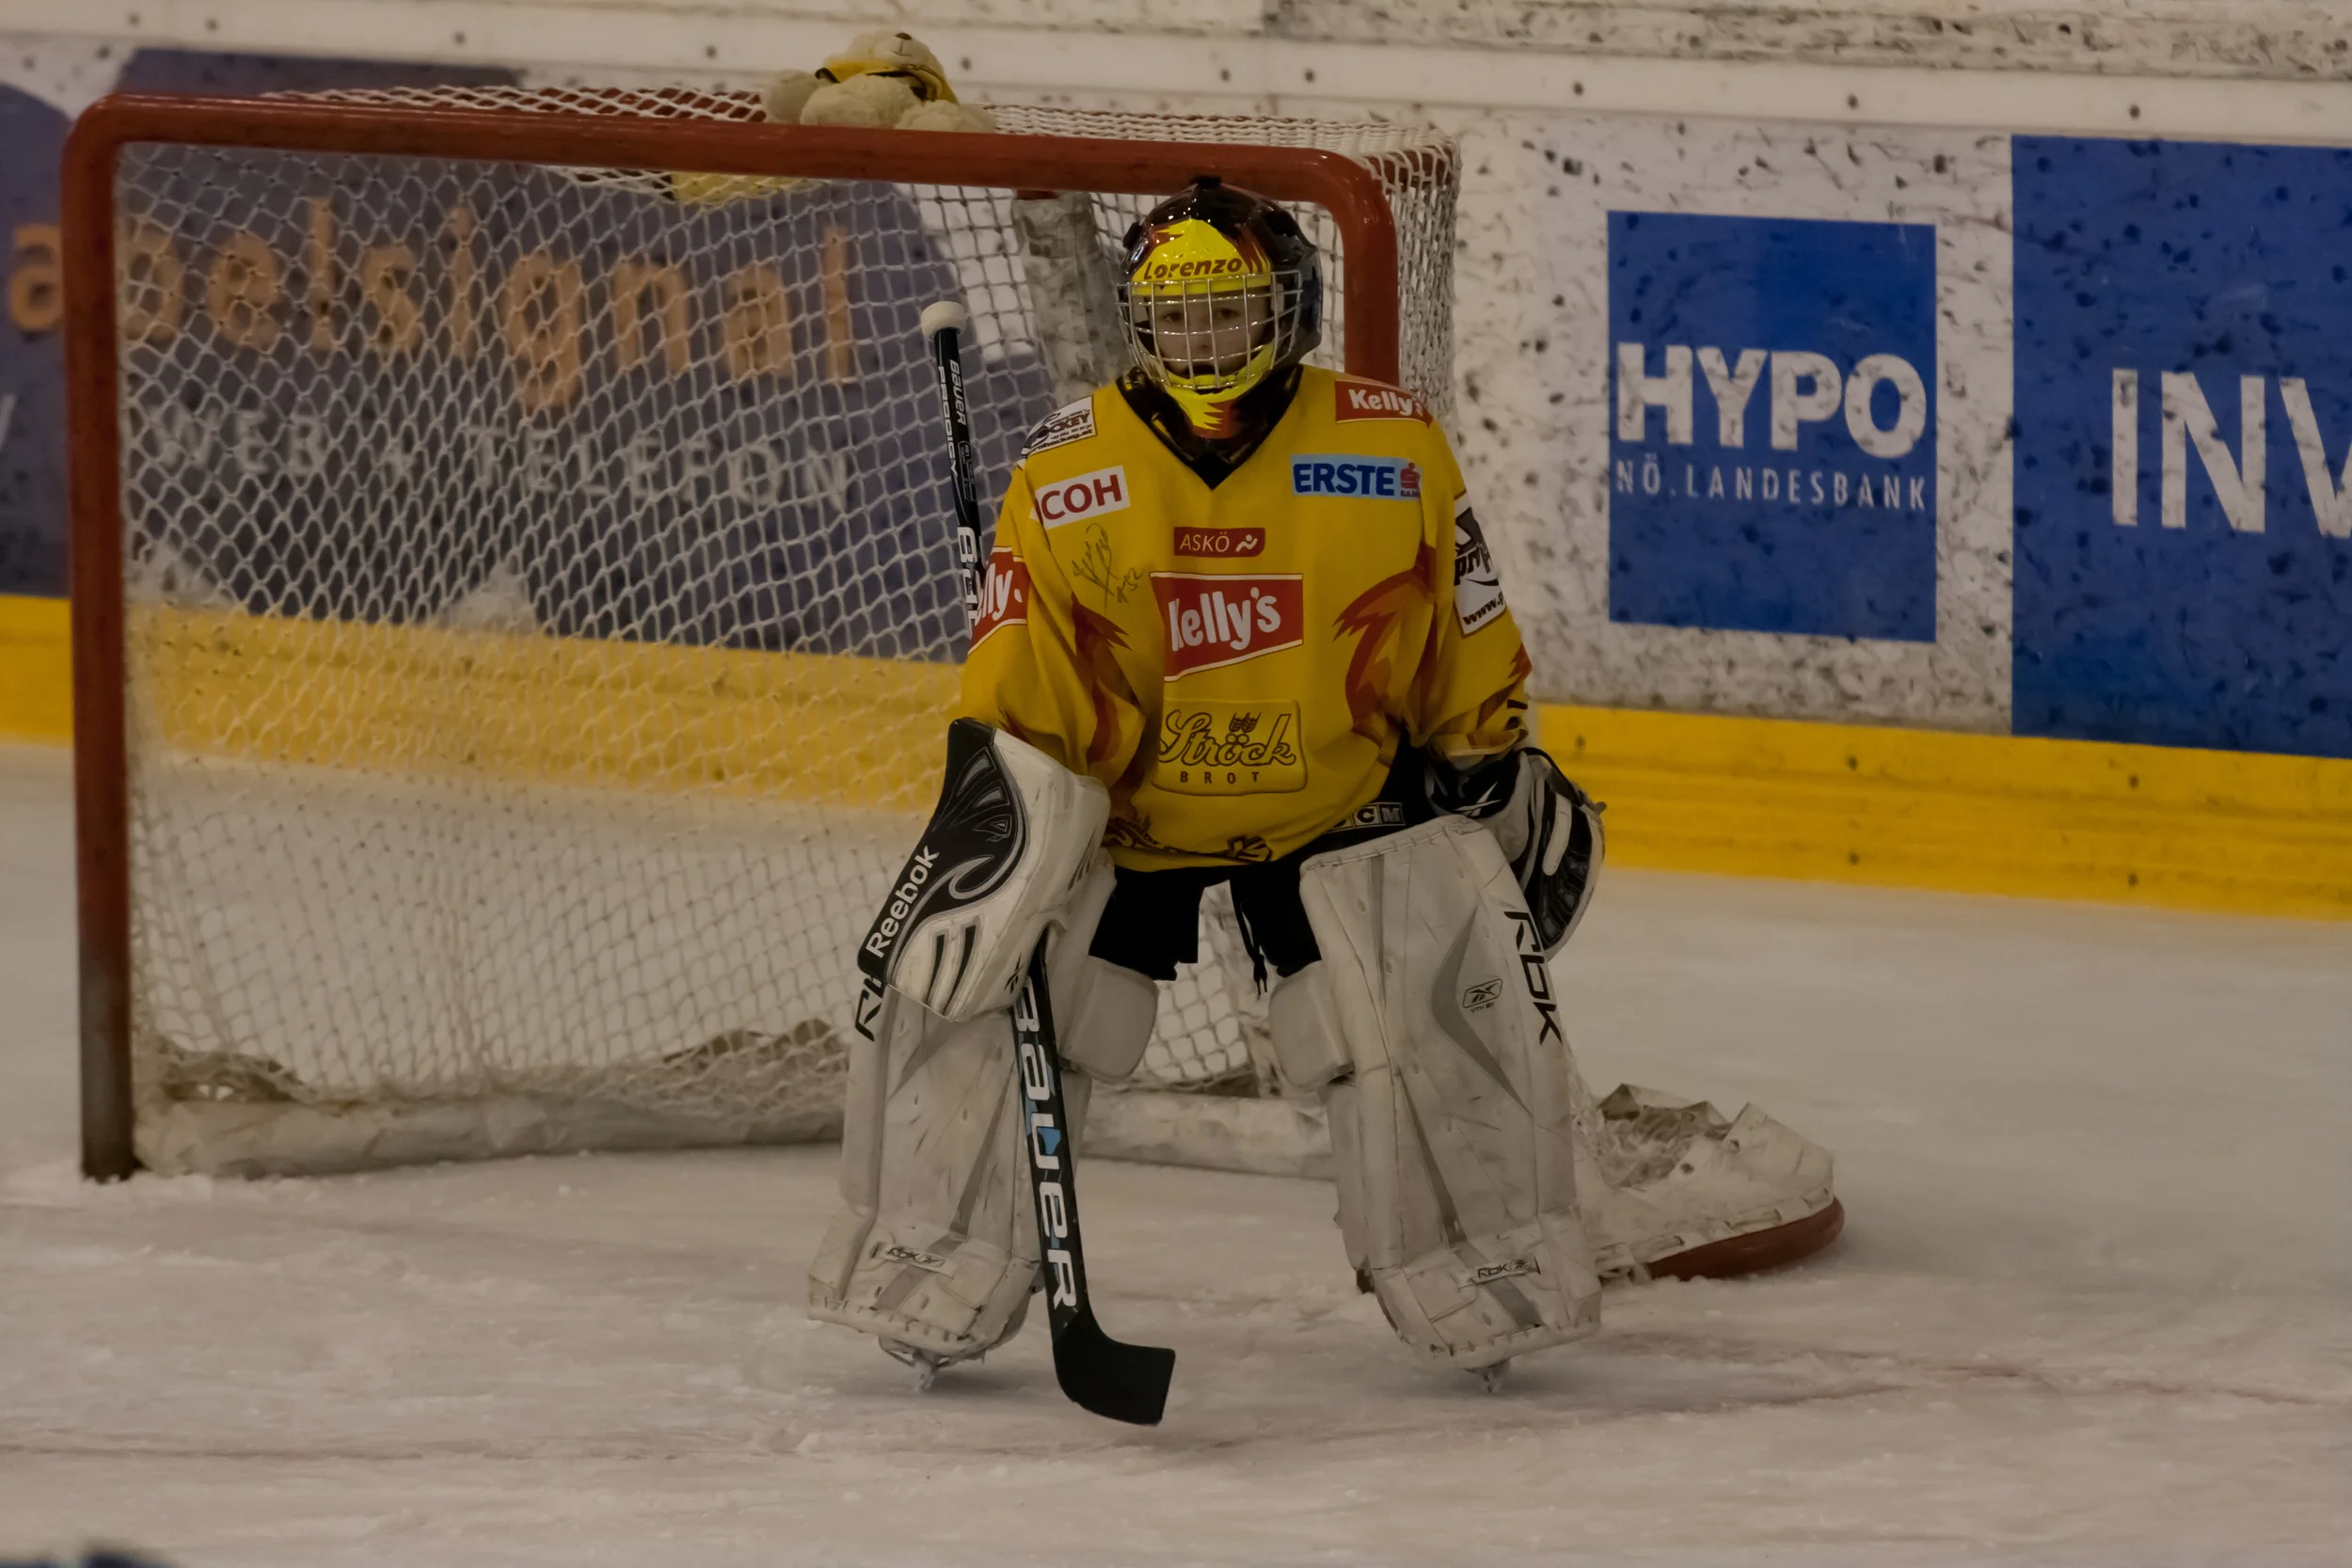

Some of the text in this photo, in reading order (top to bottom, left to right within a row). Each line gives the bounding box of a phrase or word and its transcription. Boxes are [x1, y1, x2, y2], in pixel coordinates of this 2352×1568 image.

[1143, 257, 1243, 280] Lorenzo
[949, 358, 967, 426] BAUER
[1616, 341, 1927, 459] HYPO
[2112, 368, 2352, 539] INV
[1294, 463, 1395, 497] ERSTE
[1180, 531, 1230, 553] ASKÖ
[1158, 709, 1296, 767] Ströck
[1180, 771, 1261, 784] BROT
[1335, 805, 1402, 829] CM
[865, 846, 941, 958] Reebok
